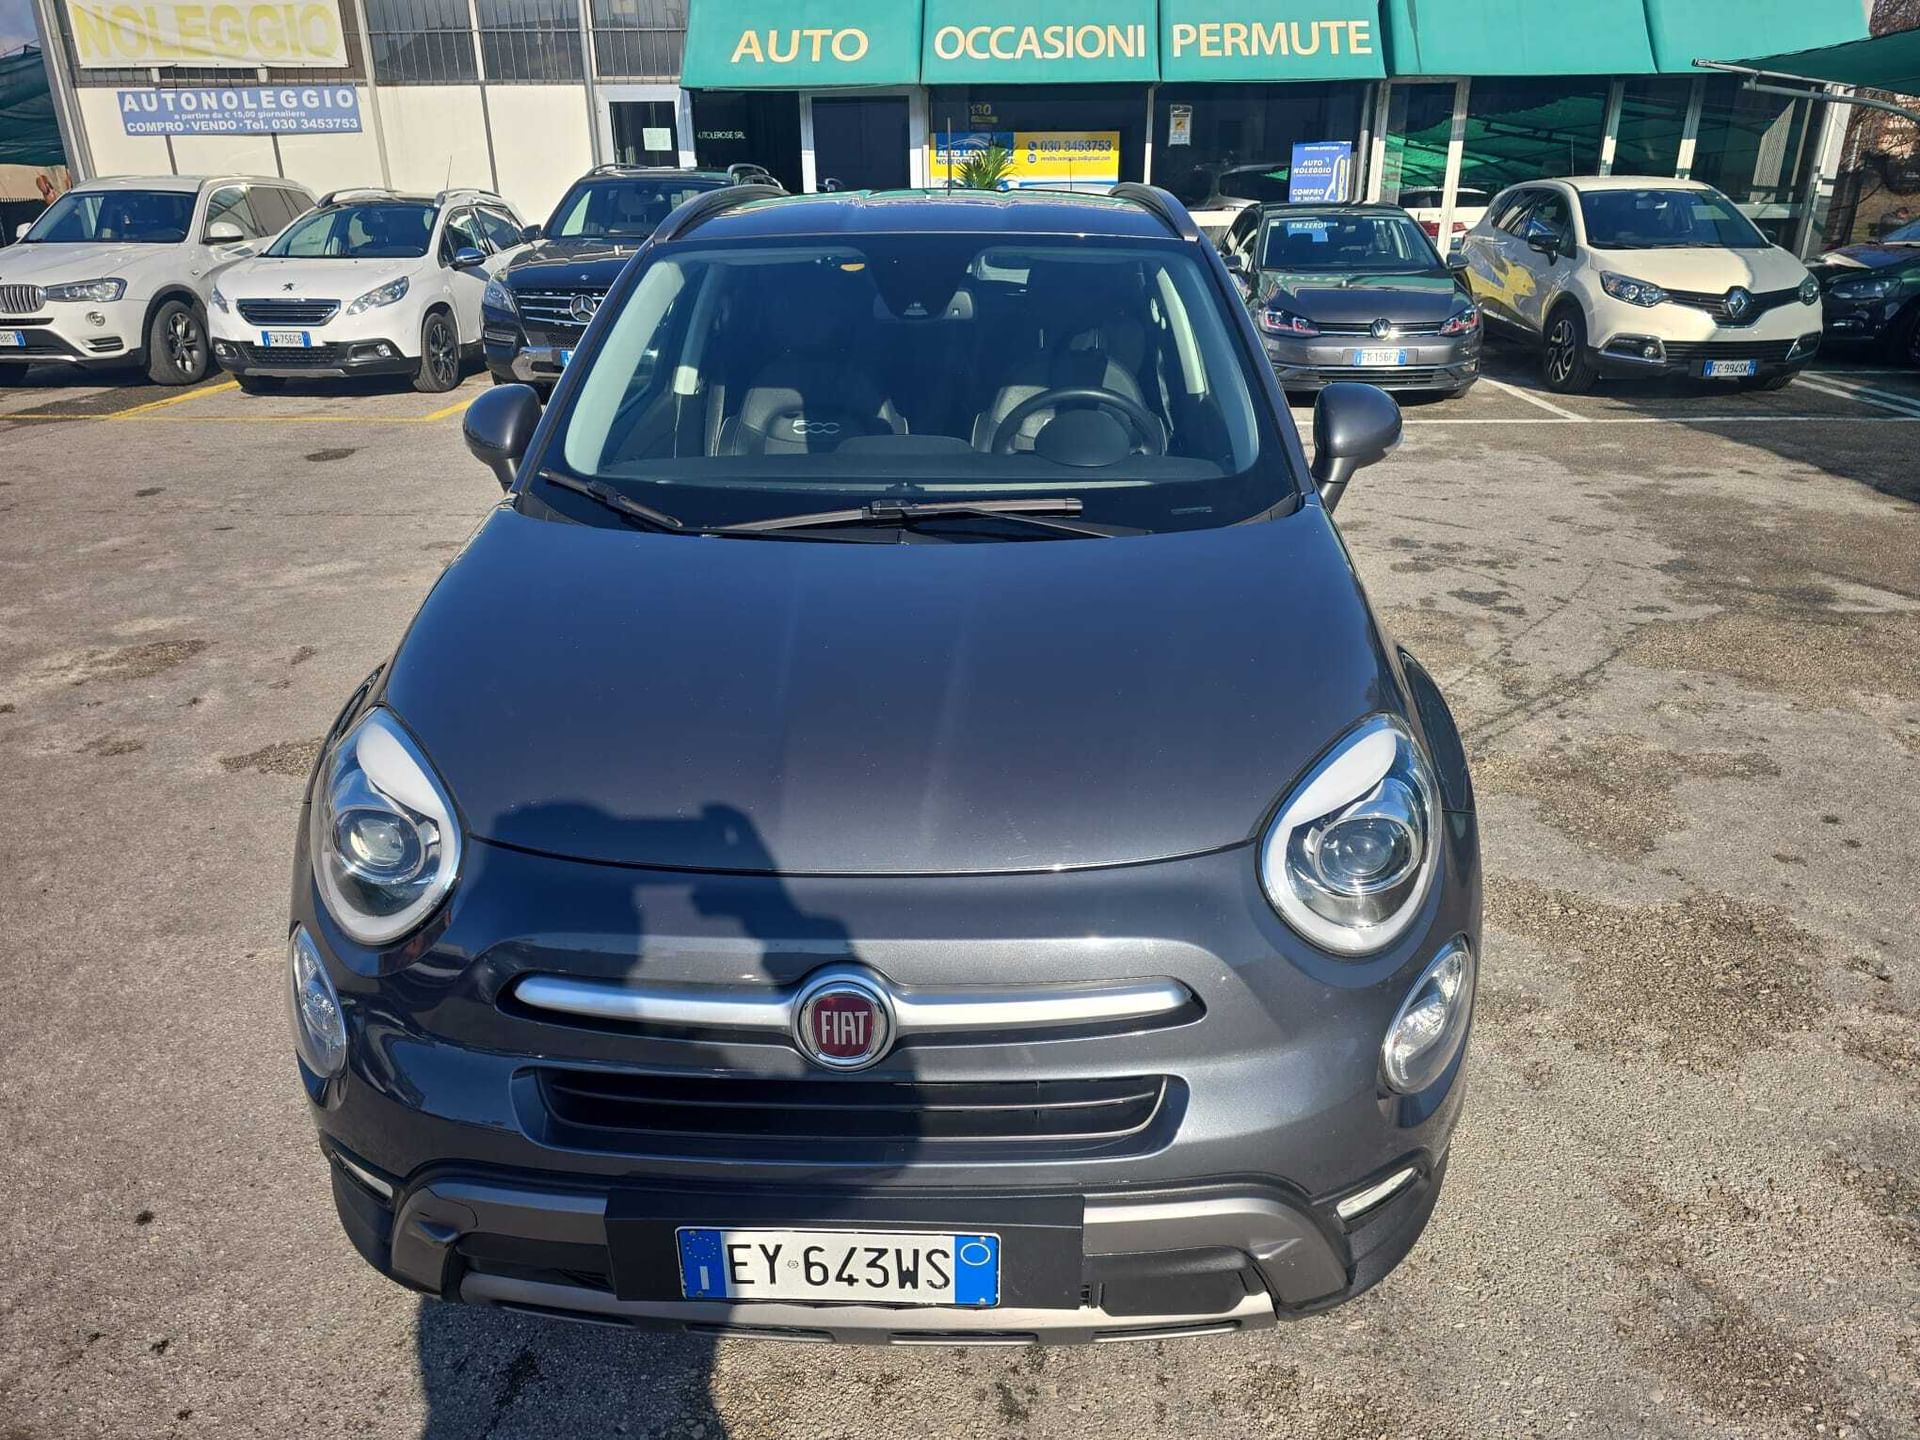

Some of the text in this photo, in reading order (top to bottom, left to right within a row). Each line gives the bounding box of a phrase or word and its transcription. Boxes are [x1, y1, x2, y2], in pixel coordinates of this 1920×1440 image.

[71, 4, 336, 58] NOLEGGIO
[730, 20, 1373, 63] AUTO OCCASIONI PERMUTE
[124, 89, 353, 112] AUTONOLEGGIO
[127, 117, 358, 132] COMPRO VENDO Tel. 030 3453753
[182, 112, 210, 121] partire
[1040, 140, 1061, 152] 030
[1302, 159, 1323, 167] AUTO
[821, 1010, 868, 1045] FIAT
[727, 1243, 783, 1285] EY
[803, 1246, 950, 1290] 643WS
